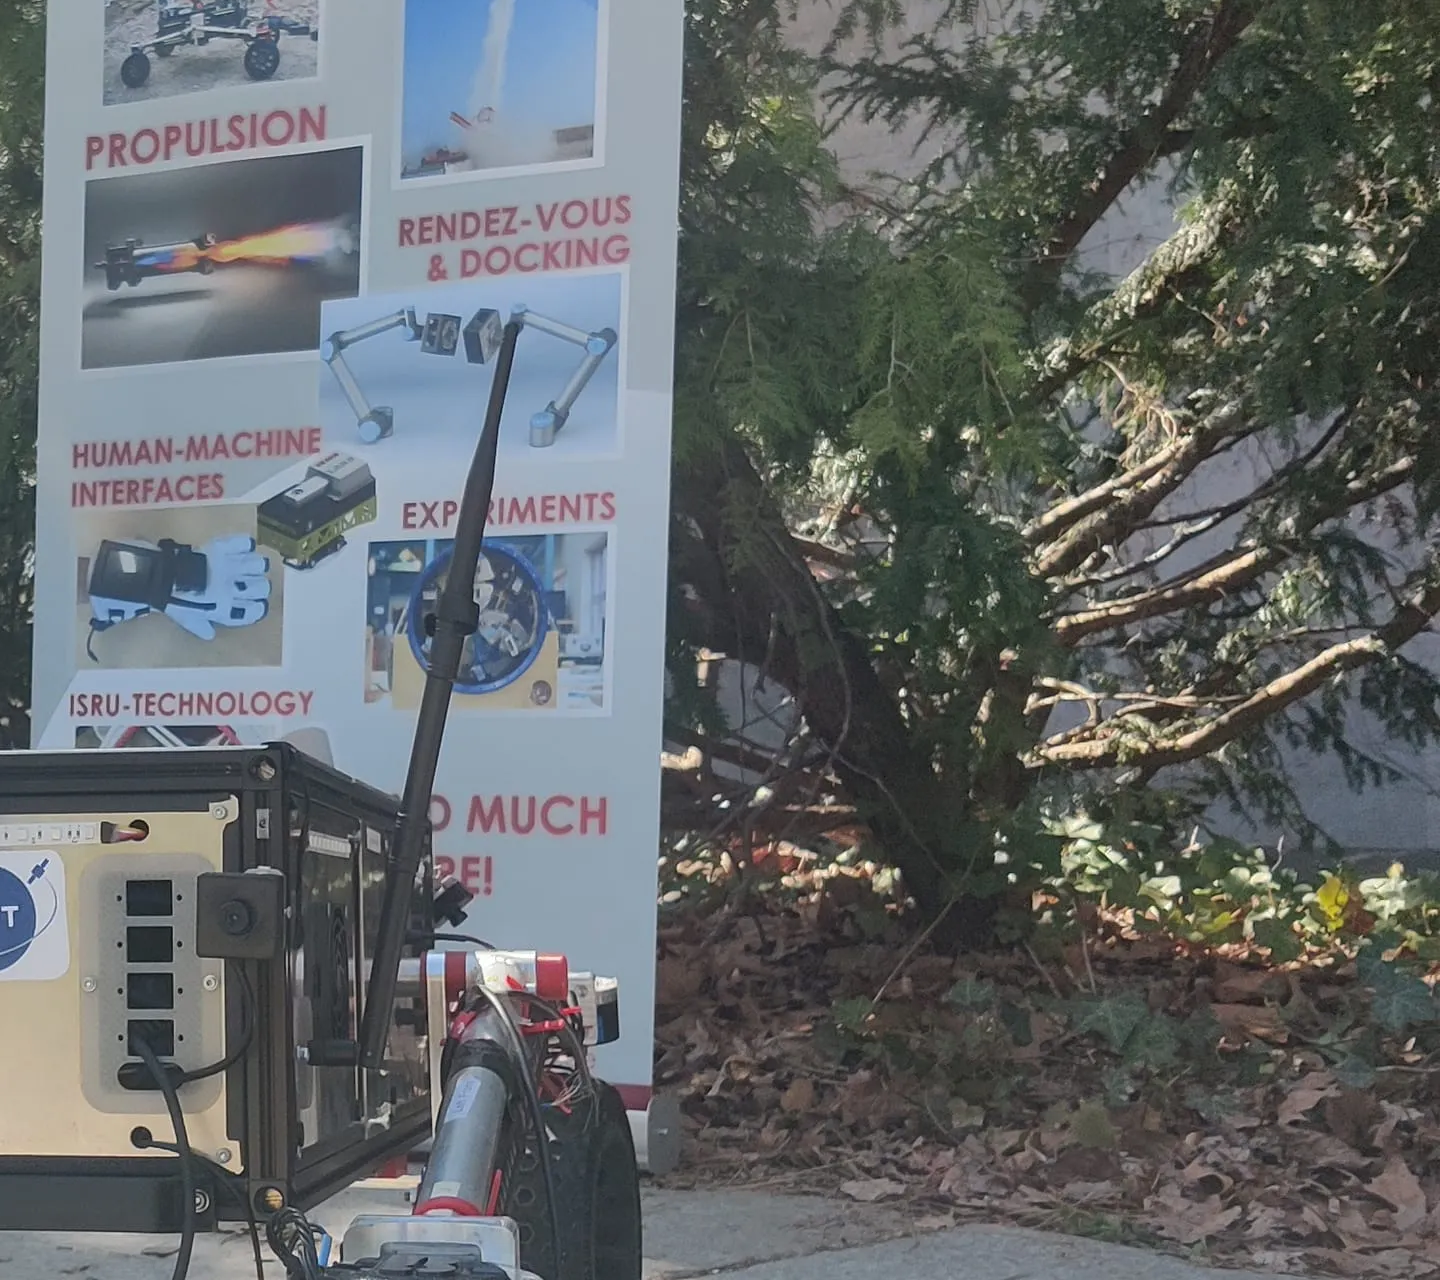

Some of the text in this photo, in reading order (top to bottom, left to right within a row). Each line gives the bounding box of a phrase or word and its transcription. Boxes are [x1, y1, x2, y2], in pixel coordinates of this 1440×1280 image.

[85, 105, 327, 170] PROPULSION
[398, 194, 632, 247] RENDEZ-VOUS
[427, 235, 631, 282] & DOCKING
[72, 427, 321, 468] HUMAN-MACHINE
[71, 473, 224, 508] INTERFACES
[69, 691, 314, 717] ISRU-TECHNOLOGY
[467, 794, 607, 835] MUCH
